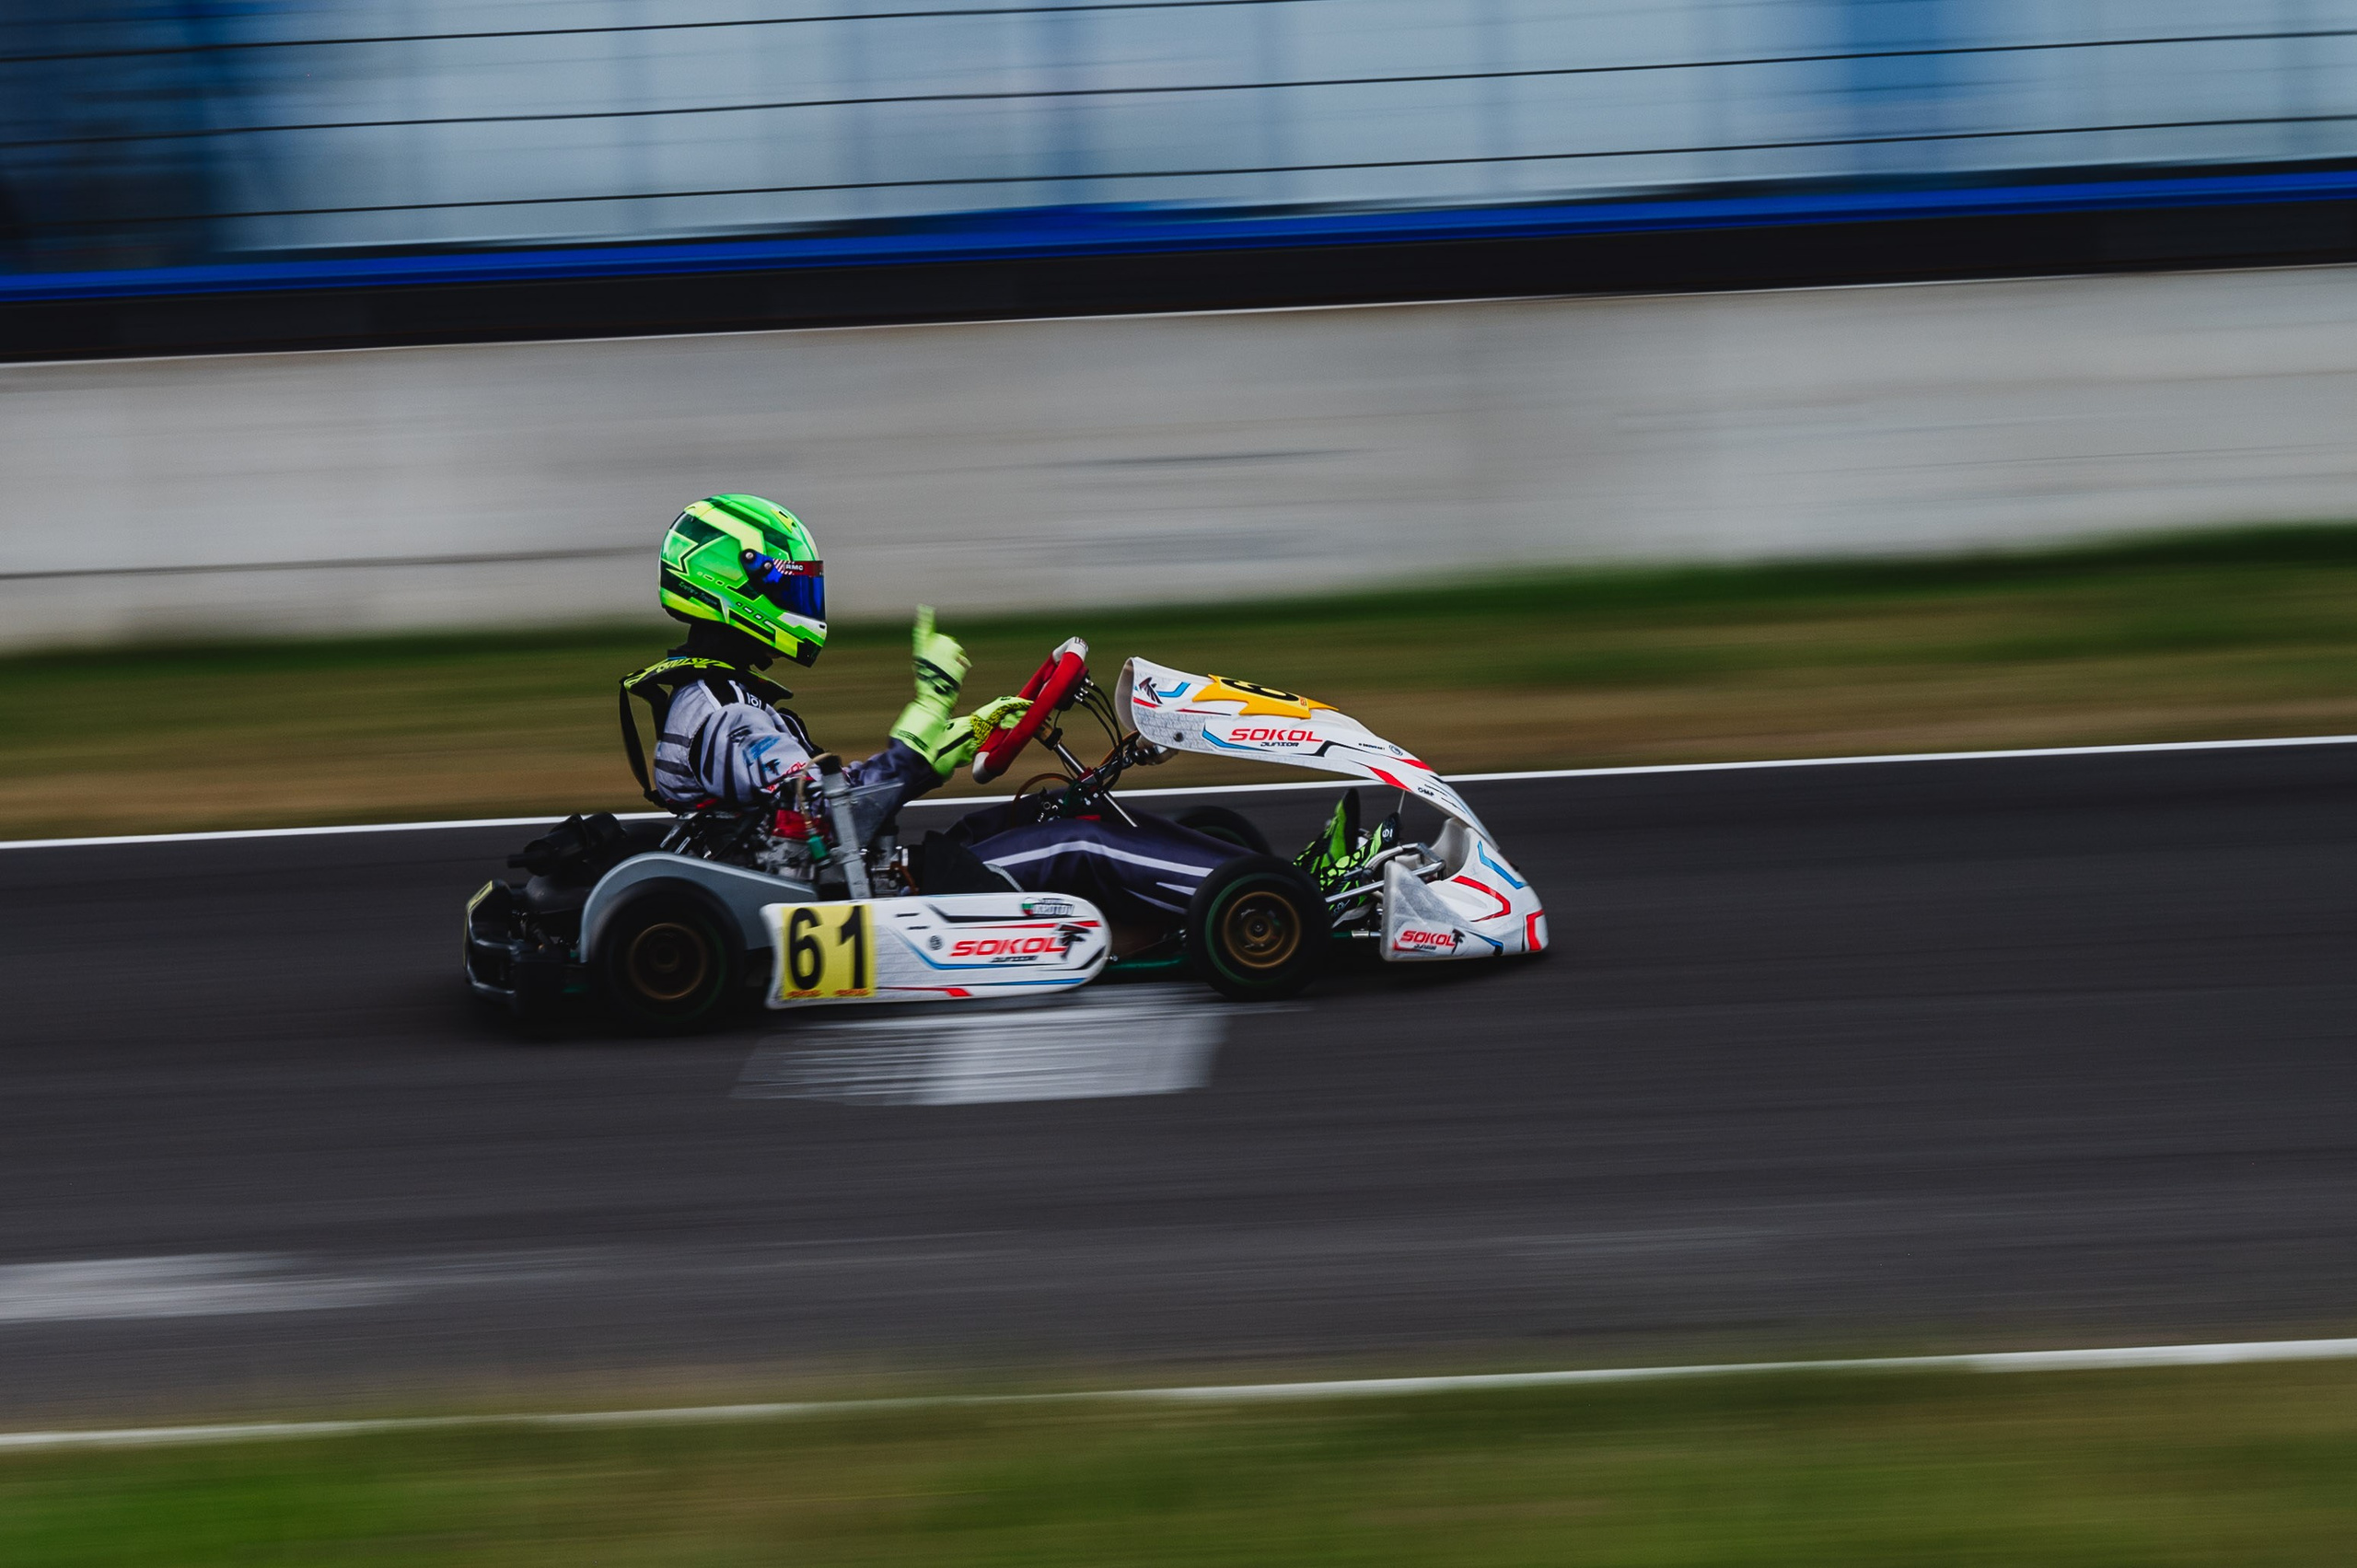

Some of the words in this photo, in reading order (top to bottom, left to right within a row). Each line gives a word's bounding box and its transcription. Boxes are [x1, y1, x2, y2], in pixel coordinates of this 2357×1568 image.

[1228, 728, 1323, 742] SOKOL
[788, 905, 867, 990] 61
[949, 937, 1066, 957] SOKOL
[1399, 930, 1456, 947] SOKOL
